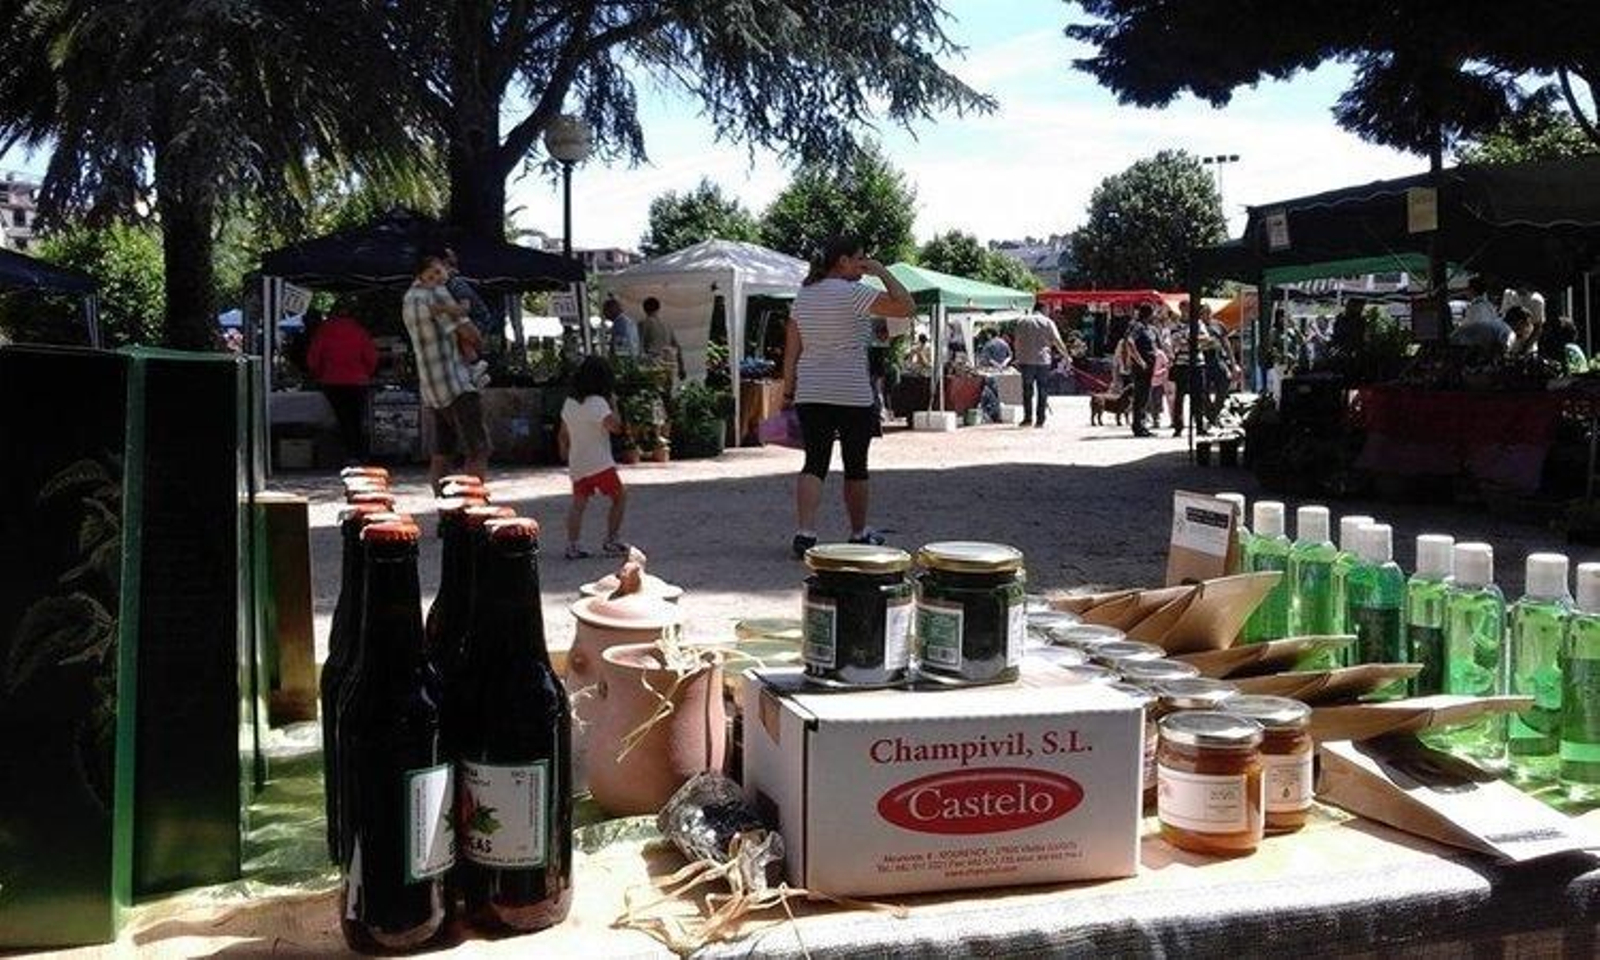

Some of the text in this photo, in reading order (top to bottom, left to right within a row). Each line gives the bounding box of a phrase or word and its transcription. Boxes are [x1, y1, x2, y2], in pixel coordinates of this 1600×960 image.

[869, 730, 1093, 766] Champivil, S.L.
[909, 783, 1054, 821] Castelo
